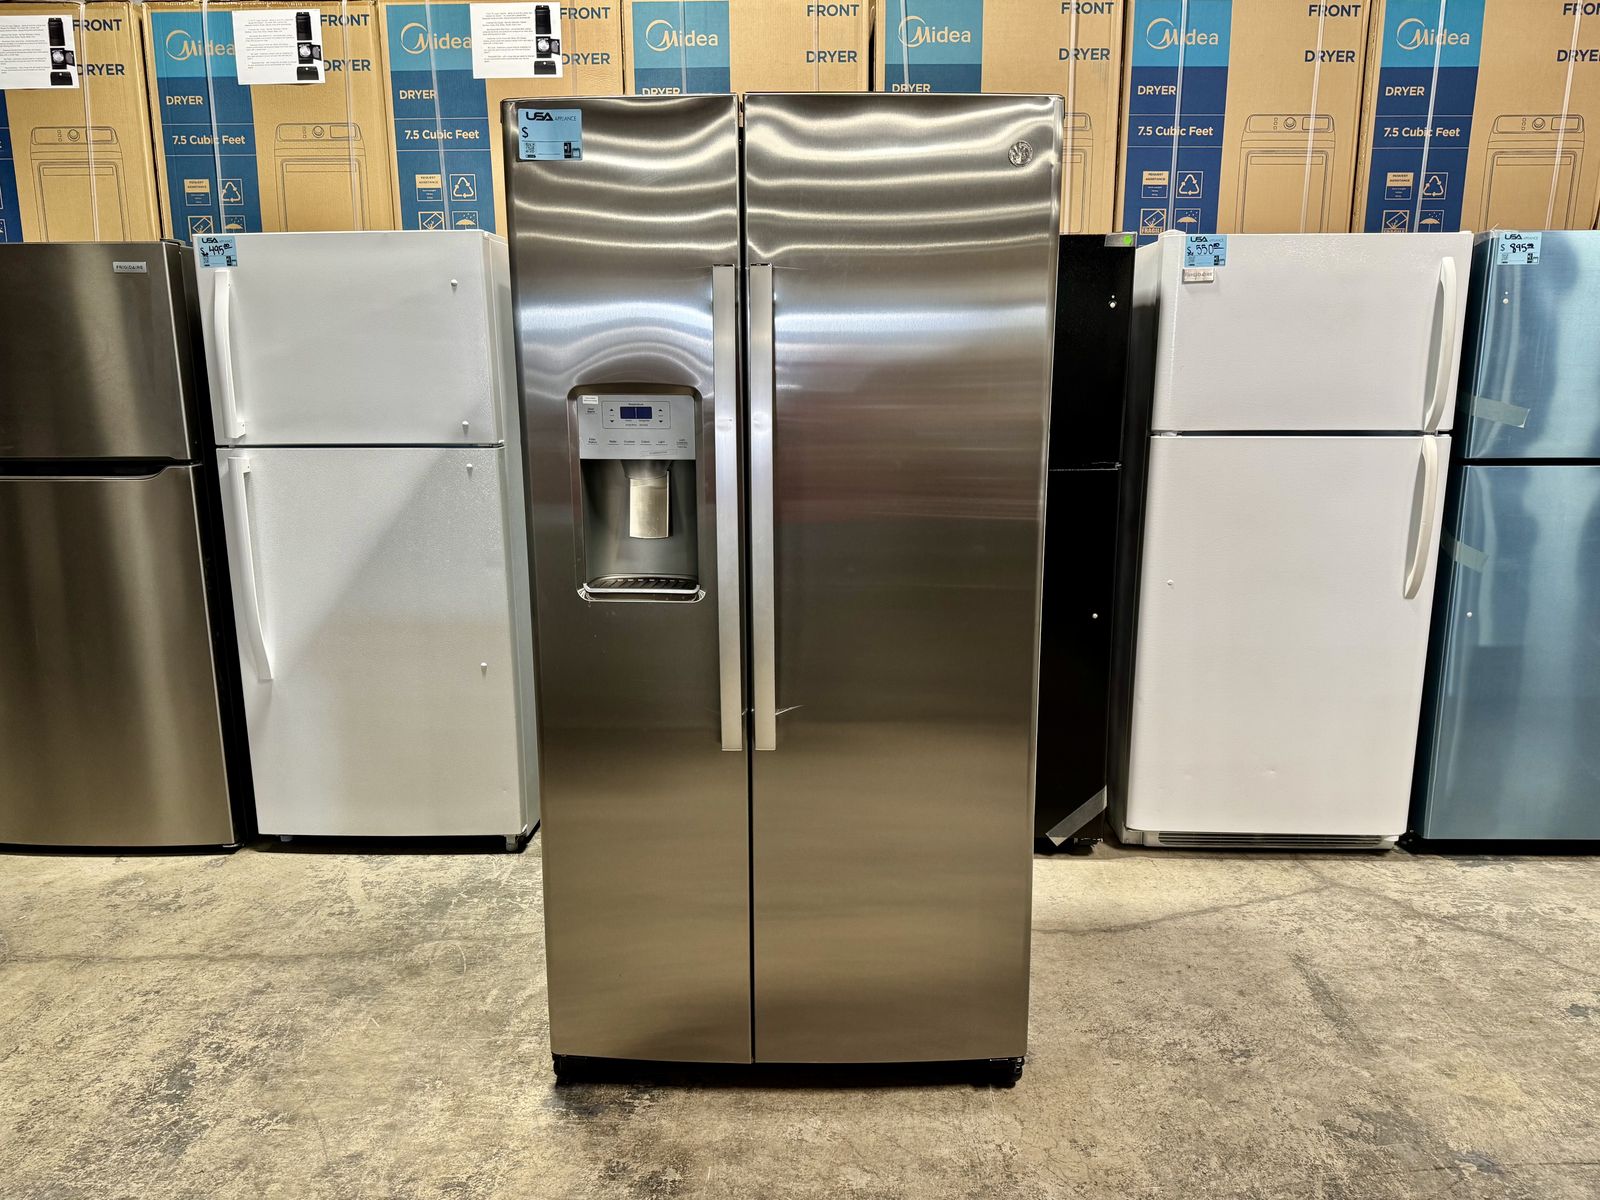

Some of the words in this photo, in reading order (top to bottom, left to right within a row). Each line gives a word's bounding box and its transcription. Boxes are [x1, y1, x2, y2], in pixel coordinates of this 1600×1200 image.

[560, 7, 610, 19] FRONT
[807, 4, 859, 16] FRONT
[1061, 2, 1114, 14] FRONT
[1308, 4, 1361, 16] FRONT
[1563, 3, 1600, 15] FRO
[72, 19, 122, 31] FRONT
[320, 14, 370, 27] FRONT
[649, 22, 718, 50] Midea
[902, 18, 971, 46] Midea
[1399, 21, 1470, 49] Midea
[404, 26, 472, 53] Midea
[562, 52, 610, 64] DRYER
[806, 50, 857, 62] DRYER
[1059, 48, 1110, 60] DRYER
[1304, 50, 1355, 62] DRYER
[1556, 50, 1600, 62] DRYE
[77, 64, 125, 76] DRYER
[642, 88, 680, 96] DRYER
[892, 84, 930, 92] DRYER
[1138, 86, 1176, 95] DRYER
[1385, 86, 1425, 96] DRYER
[166, 96, 204, 105] DRYER
[400, 90, 437, 99] DRYER
[526, 112, 554, 121] USA
[404, 130, 420, 139] 7.5
[422, 130, 453, 139] Cubic
[456, 130, 480, 139] Feet
[522, 127, 528, 138] $
[1138, 126, 1152, 136] 7.5
[1156, 126, 1186, 136] Cubic
[1190, 126, 1214, 136] Feet
[1384, 128, 1399, 137] 7.5
[1402, 127, 1432, 136] Cubic
[1436, 127, 1460, 136] Feet
[172, 136, 186, 144] 7.5
[190, 135, 219, 144] Cubic
[222, 135, 246, 144] Feet
